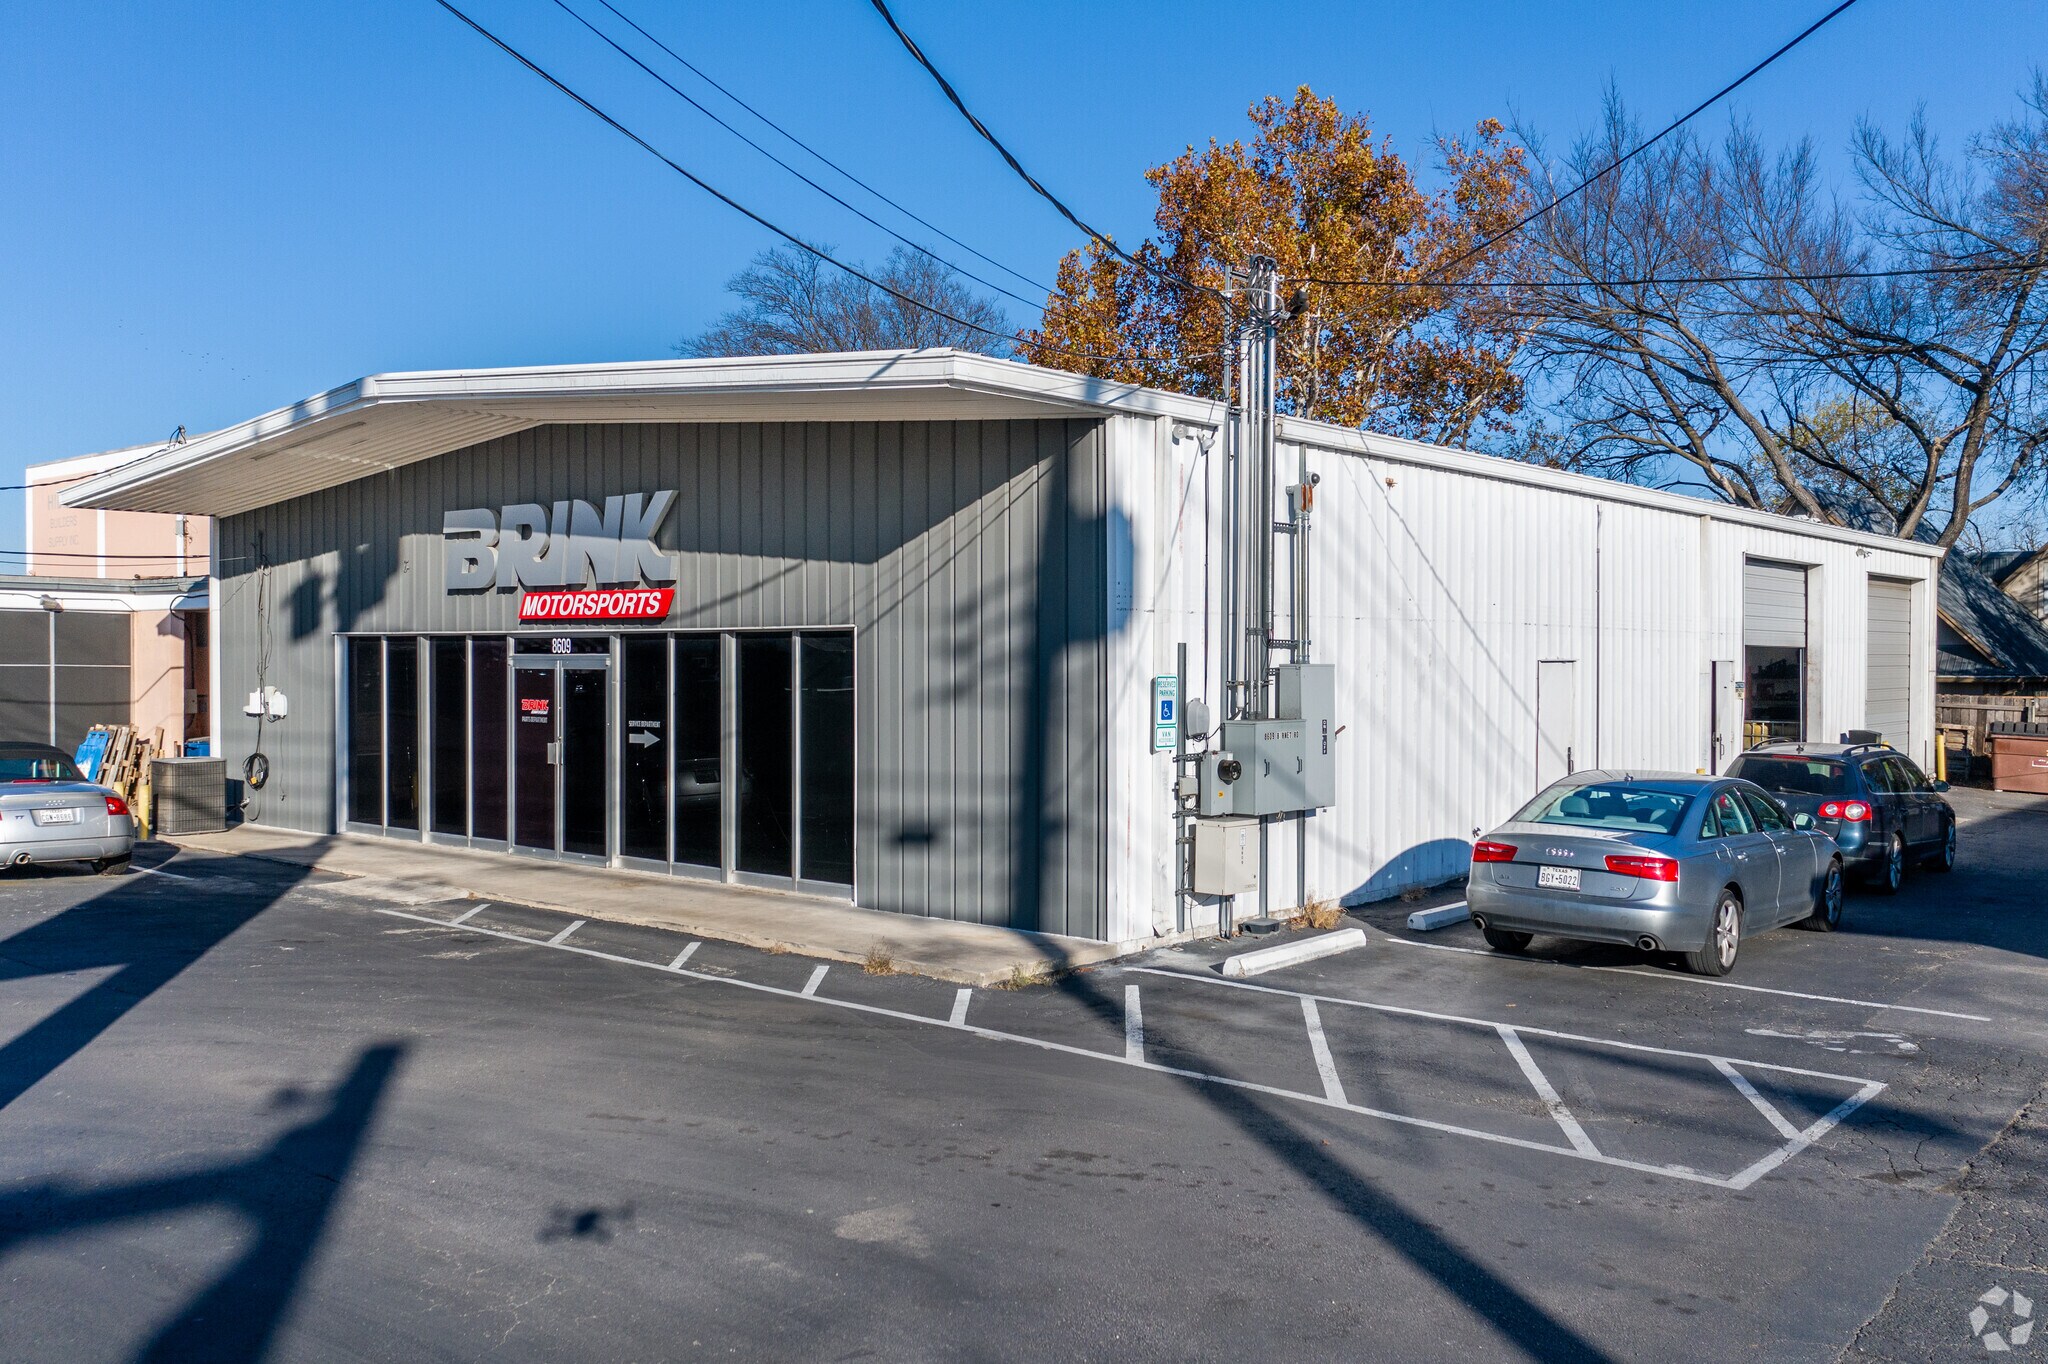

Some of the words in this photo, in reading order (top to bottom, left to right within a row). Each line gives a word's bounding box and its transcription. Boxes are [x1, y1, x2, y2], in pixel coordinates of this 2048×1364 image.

[443, 490, 679, 593] BRINK
[522, 591, 662, 617] MOTORSPORTS
[552, 638, 571, 653] 8609
[522, 699, 549, 711] BRINK
